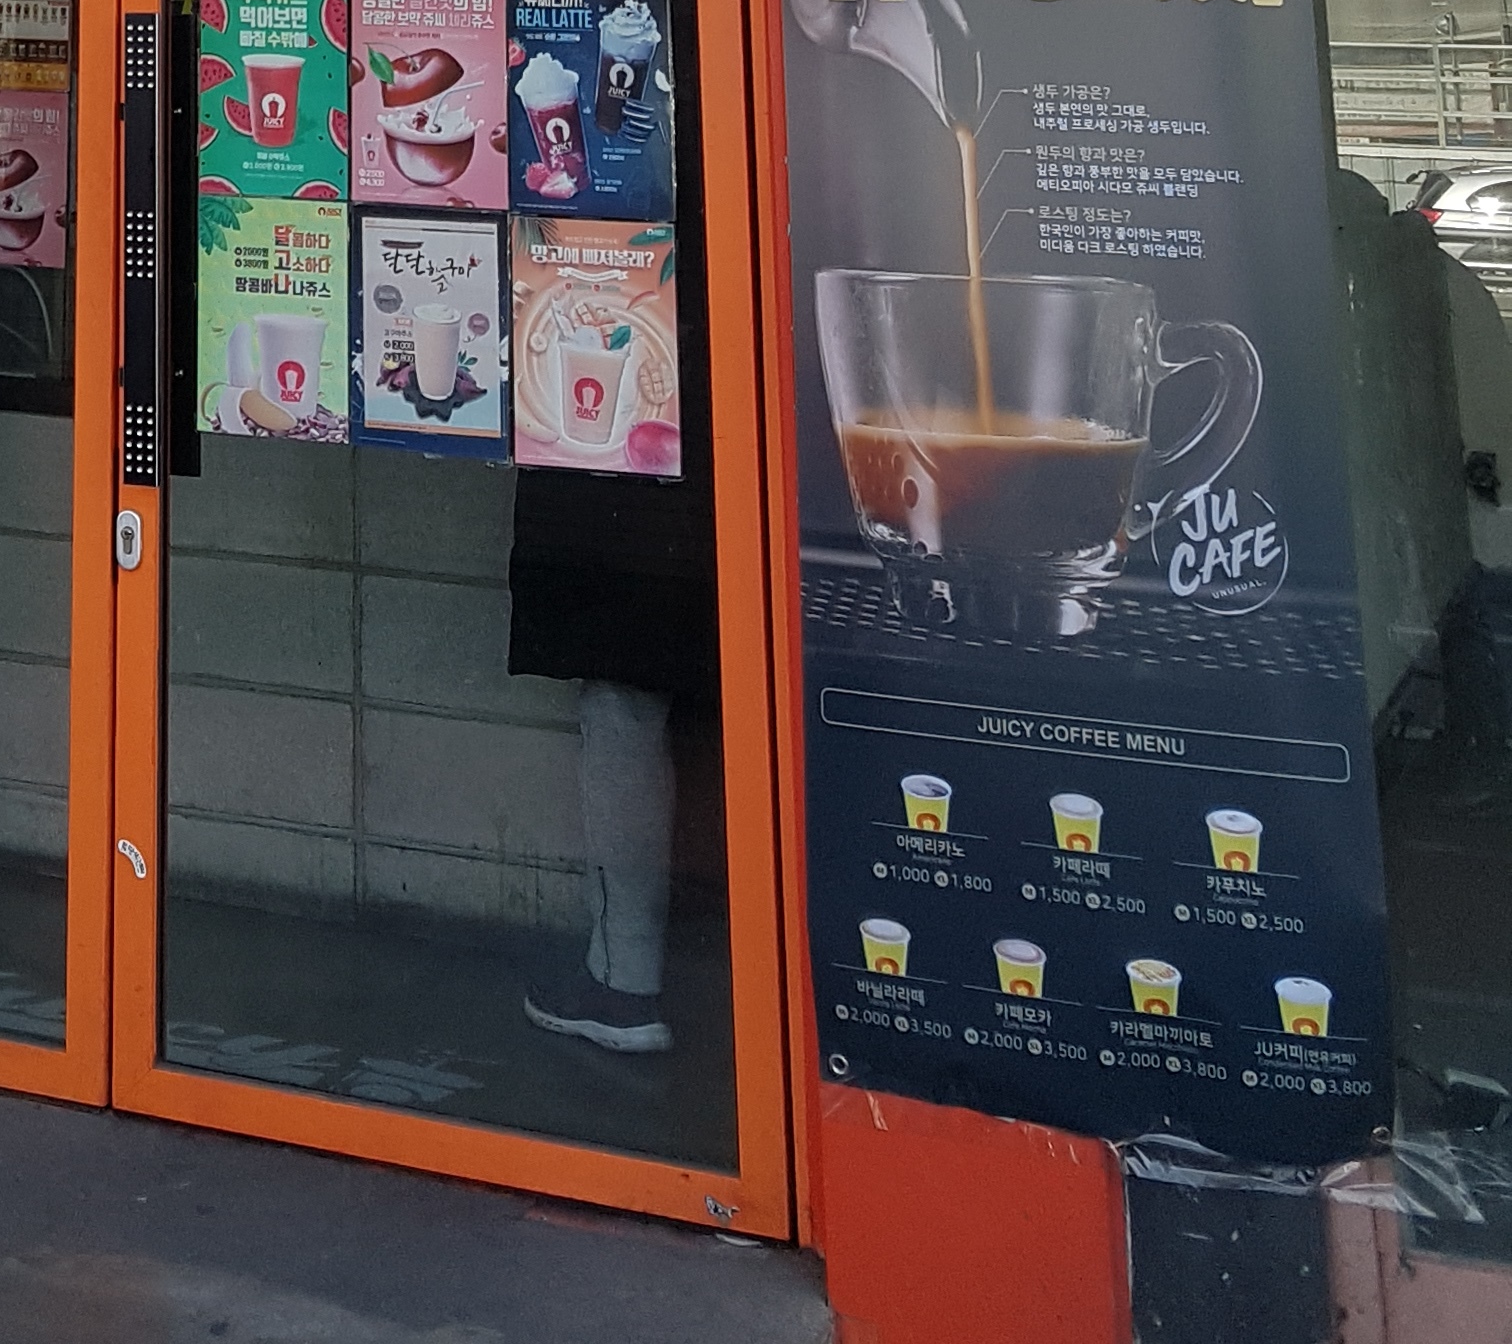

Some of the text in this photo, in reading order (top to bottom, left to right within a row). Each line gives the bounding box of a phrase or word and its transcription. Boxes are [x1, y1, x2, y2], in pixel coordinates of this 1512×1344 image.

[239, 6, 307, 30] 먹어보면
[423, 12, 446, 27] 쥬씨
[515, 8, 594, 29] REAL LATTE
[1032, 84, 1111, 100] 생두 가공은?
[1096, 104, 1109, 117] 맛
[1120, 119, 1145, 134] 가공
[1110, 147, 1146, 163] 맛은?
[1153, 167, 1178, 181] 모두
[1136, 181, 1160, 196] 쥬씨
[1038, 205, 1132, 223] 로스팅 정도는?
[1088, 225, 1112, 240] 가장
[530, 243, 579, 265] 망고에
[1077, 240, 1102, 254] 다크
[1104, 242, 1140, 257] 로스팅
[1168, 521, 1282, 597] CAFE
[976, 715, 1186, 756] JUICY COFFEE MENU
[896, 833, 966, 858] 아메리카노
[1052, 855, 1111, 879] 카페라떼
[1206, 875, 1267, 898] 카푸치노
[856, 979, 926, 1007] 바닐라라떼
[994, 1002, 1052, 1027] 카페모카
